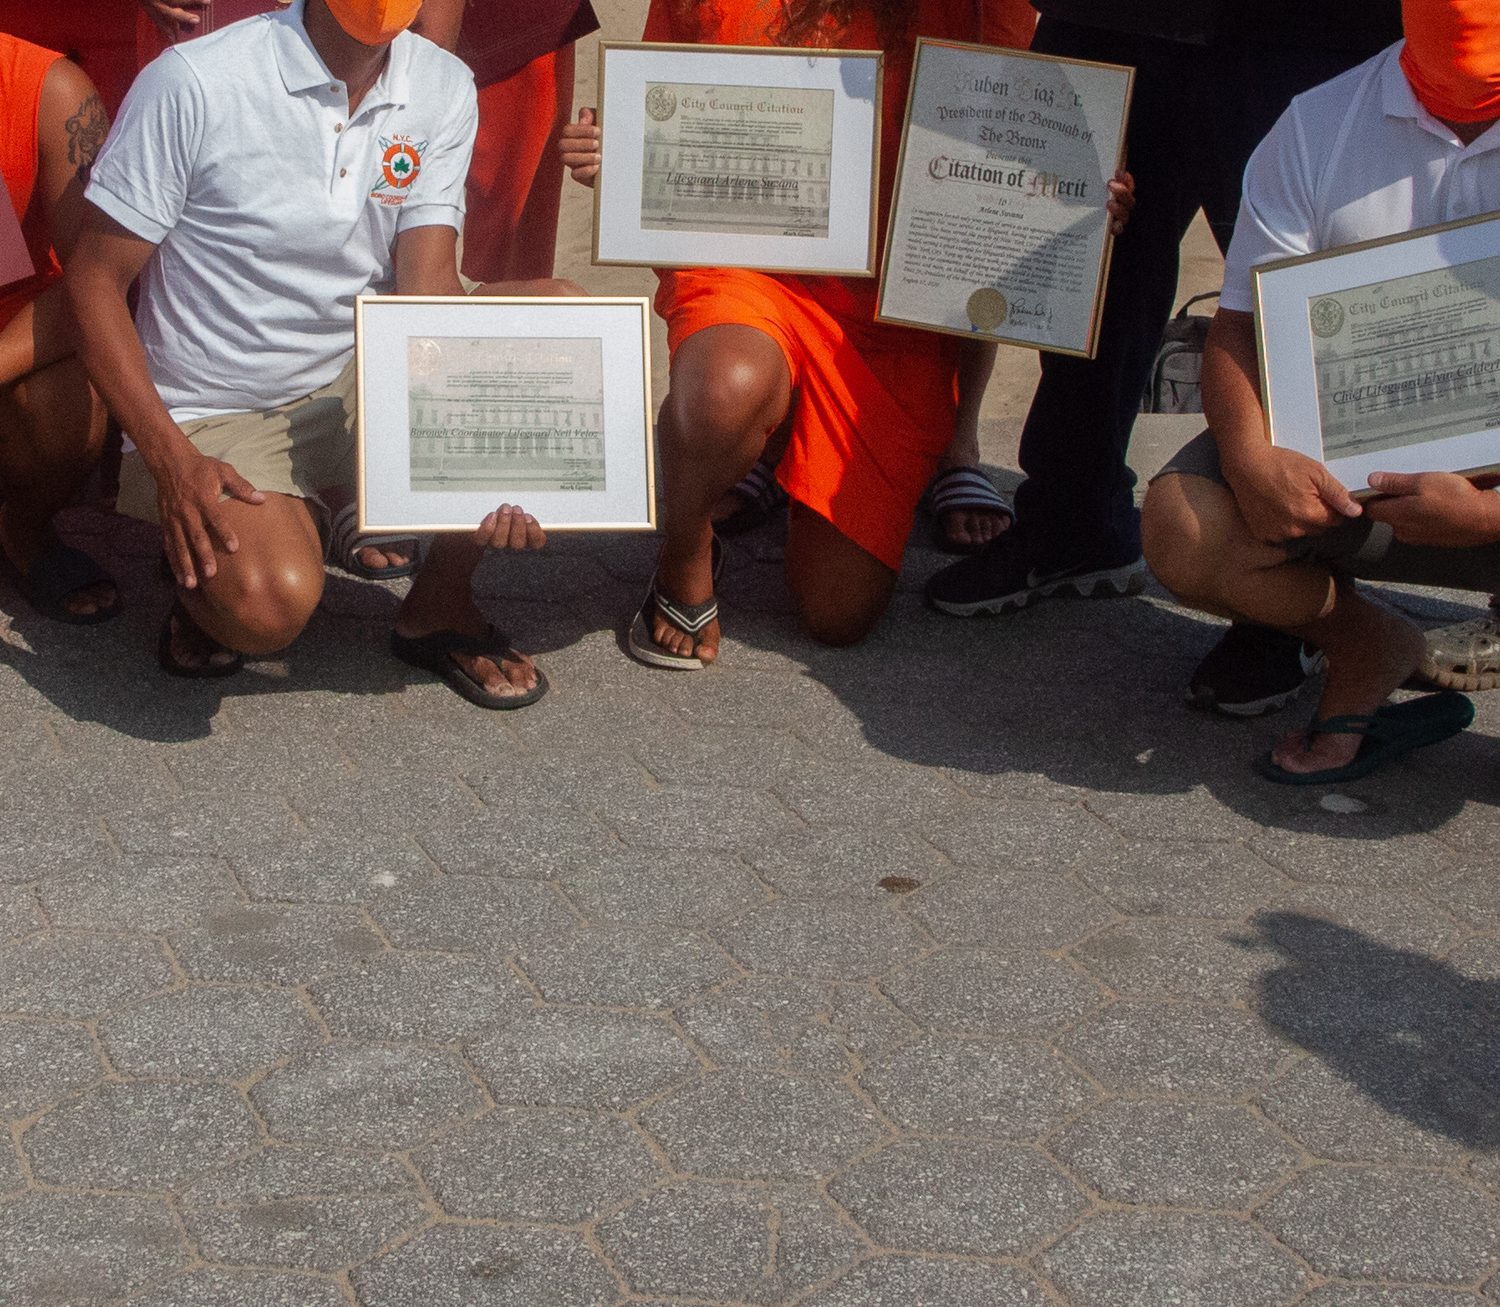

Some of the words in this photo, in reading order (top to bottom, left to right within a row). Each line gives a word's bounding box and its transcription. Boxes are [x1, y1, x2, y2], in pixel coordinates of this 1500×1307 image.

[953, 71, 1009, 96] Ruben
[680, 97, 706, 111] City
[709, 99, 754, 112] Council
[757, 101, 804, 115] Citation
[936, 105, 992, 121] President
[994, 107, 1006, 120] of
[1008, 108, 1026, 123] the
[1028, 111, 1080, 139] Borough
[1081, 130, 1095, 143] of
[392, 133, 414, 143] N.Y.C.
[978, 125, 1003, 143] The
[1006, 129, 1048, 150] Bronx
[666, 171, 719, 187] Lifeguard
[721, 173, 758, 188] Arlene
[761, 175, 799, 191] Suzana
[927, 155, 1003, 185] Citation
[1006, 169, 1026, 188] of
[1026, 170, 1088, 199] Merit
[1348, 303, 1376, 316] City
[1380, 291, 1428, 310] Council
[1434, 279, 1485, 299] Citation
[1332, 388, 1363, 405] Chief
[1366, 375, 1421, 398] Lifeguard
[1424, 369, 1453, 386] Elvin
[410, 427, 448, 439] Borough
[450, 427, 506, 439] Coordinator
[508, 428, 551, 439] Lifeguard
[574, 429, 599, 438] Veloz
